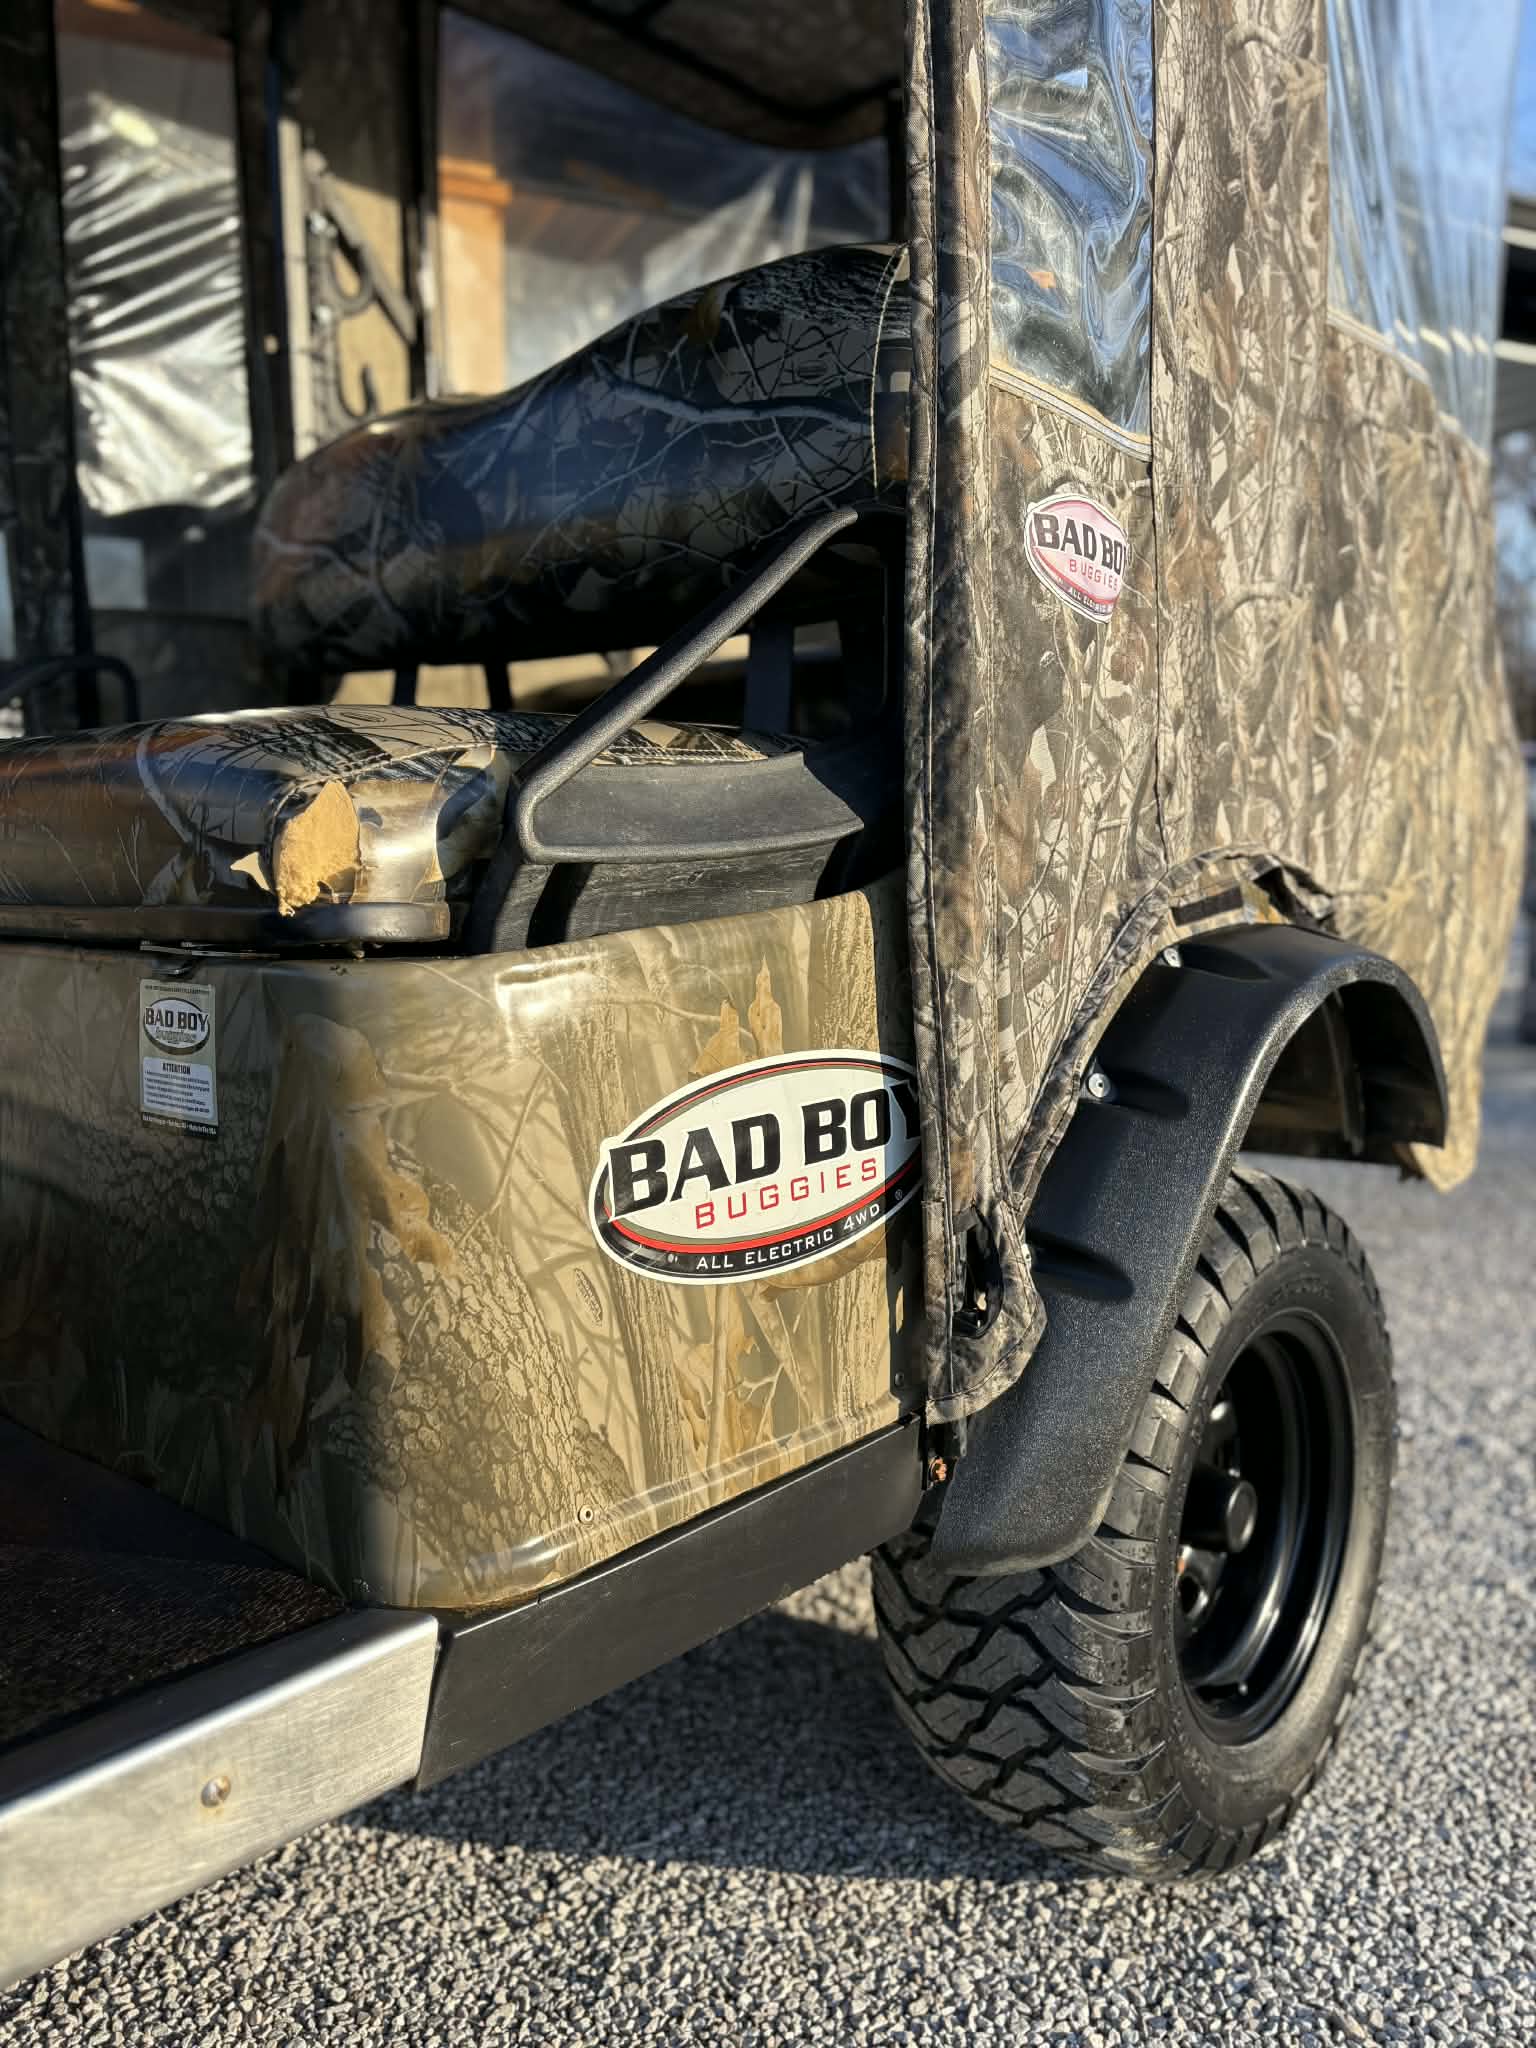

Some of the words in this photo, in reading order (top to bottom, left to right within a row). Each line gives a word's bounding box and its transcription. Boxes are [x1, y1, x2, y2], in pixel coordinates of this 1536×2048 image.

[1033, 512, 1097, 562] BAD
[1100, 533, 1126, 576] BO
[146, 1007, 174, 1027] BAD
[178, 1011, 208, 1033] BOY
[162, 1062, 191, 1075] ATTENTION
[608, 1112, 781, 1218] BAD
[695, 1157, 878, 1229] BUGGIES
[696, 1255, 734, 1270] ALL
[745, 1227, 834, 1266] ELECTRIC
[843, 1203, 881, 1231] 4WD
